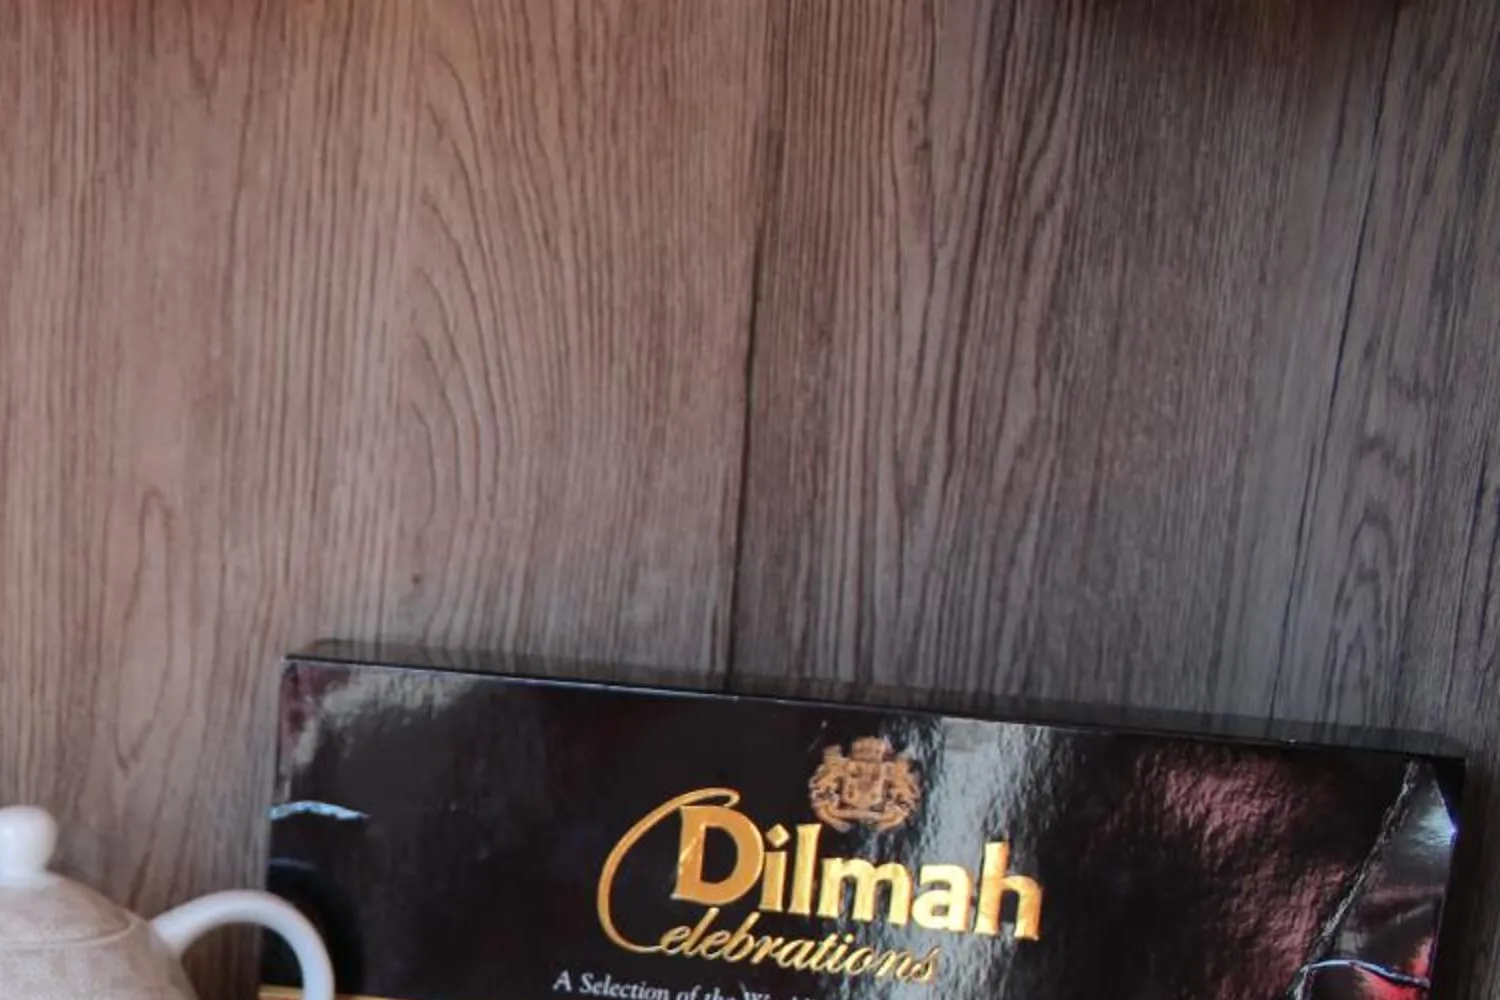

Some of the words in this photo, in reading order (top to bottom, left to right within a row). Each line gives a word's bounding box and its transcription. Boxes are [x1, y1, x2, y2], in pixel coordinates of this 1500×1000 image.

[597, 787, 940, 983] Celebrations
[672, 804, 1043, 941] Dilmah
[552, 969, 573, 992] A
